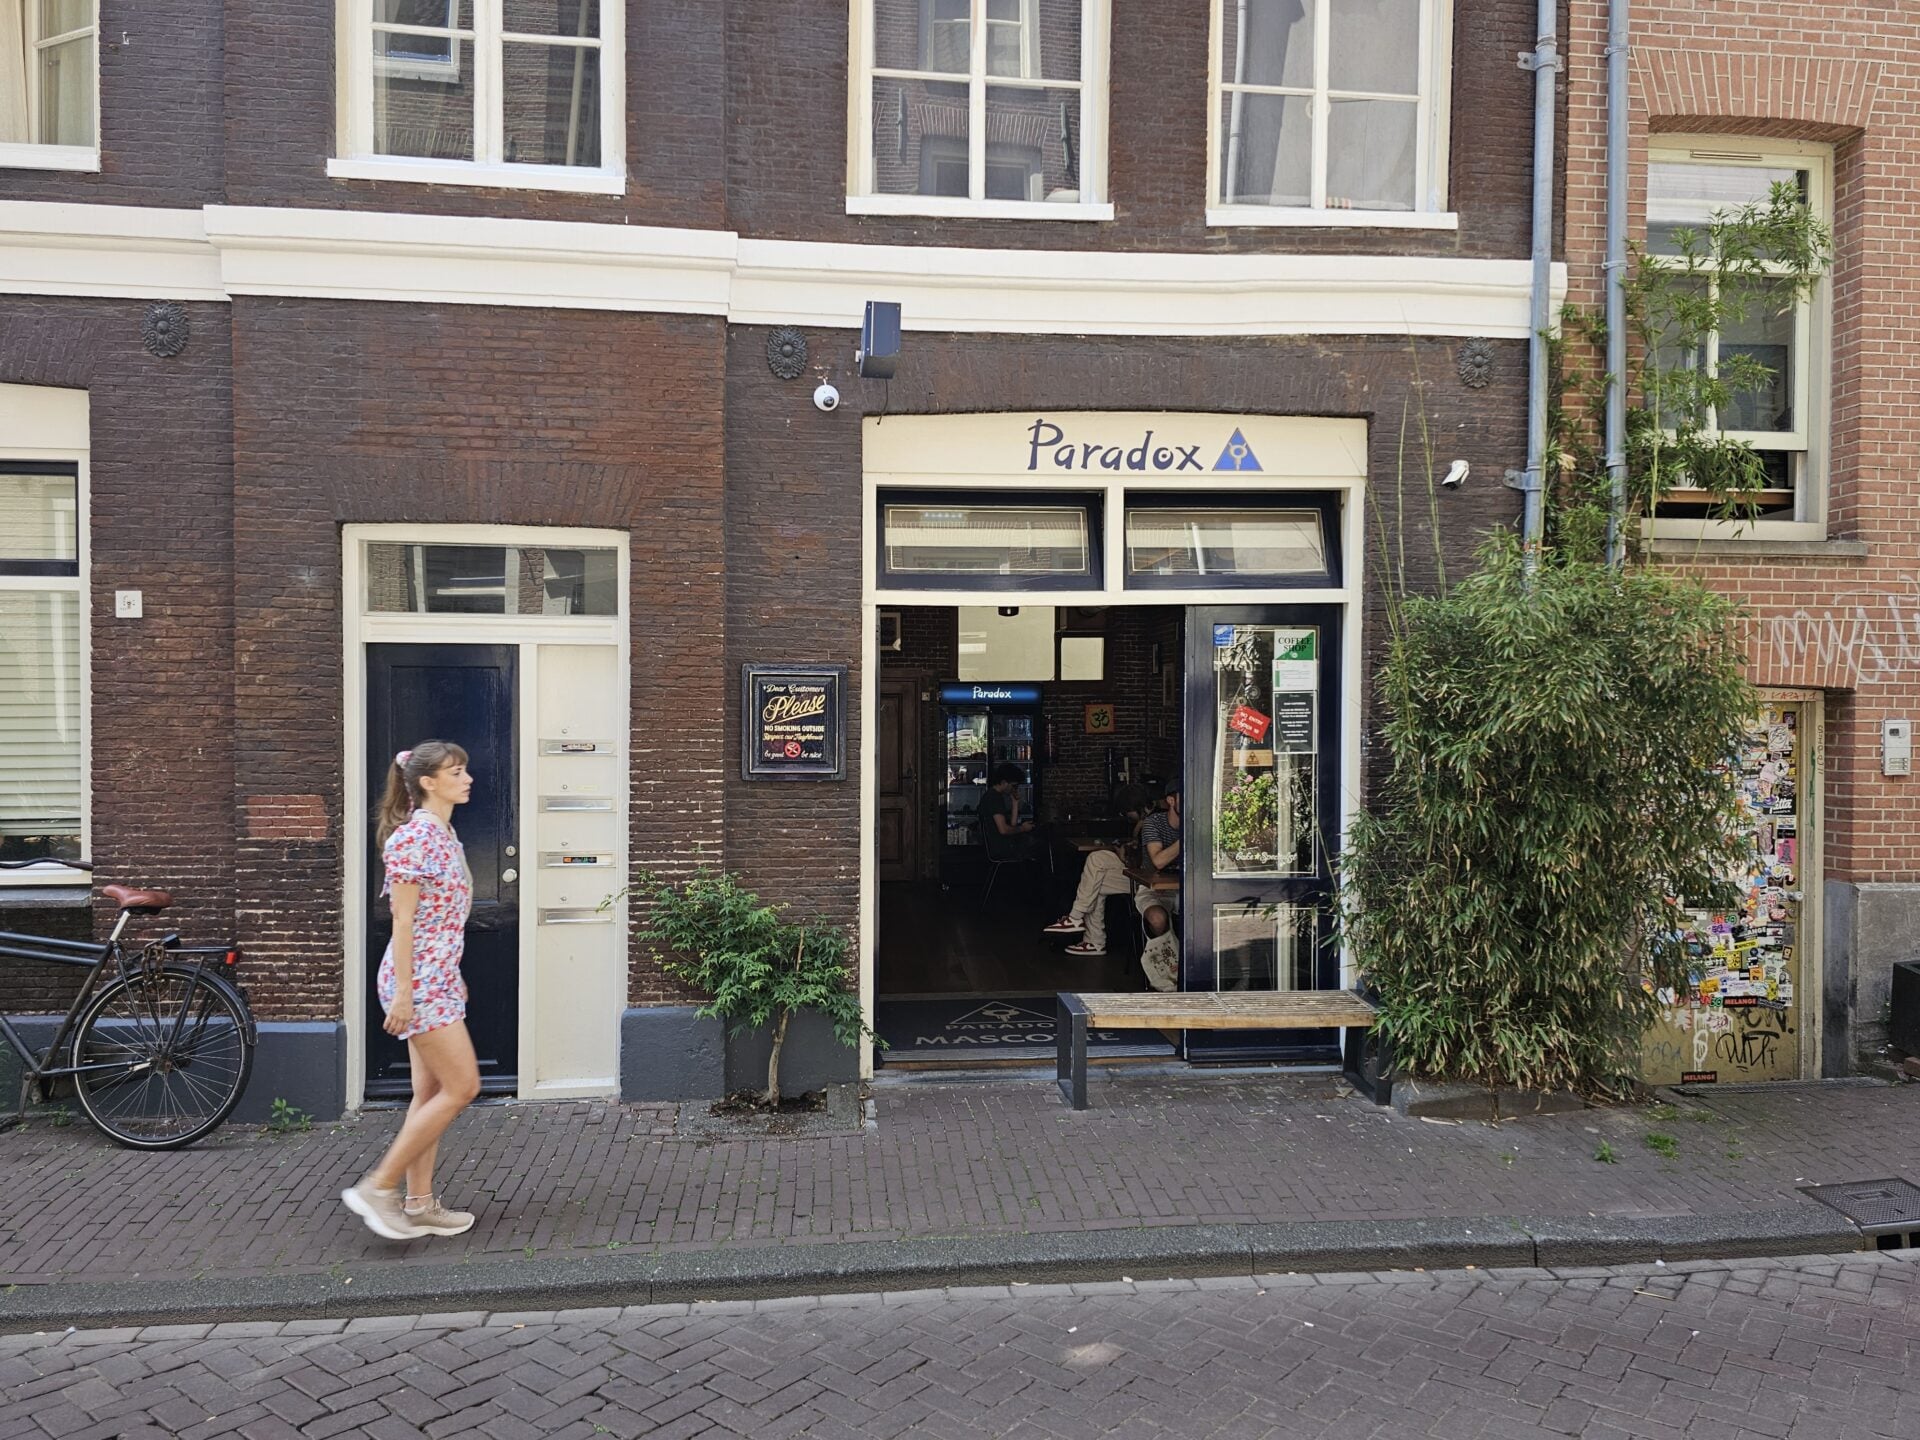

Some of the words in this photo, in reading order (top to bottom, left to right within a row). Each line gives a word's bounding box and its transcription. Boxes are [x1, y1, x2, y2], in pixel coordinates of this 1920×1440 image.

[1027, 418, 1204, 472] Paradox
[1278, 636, 1312, 645] COFFEE
[1283, 644, 1307, 652] SHOP
[972, 686, 1012, 699] Paradox
[763, 694, 826, 723] Please
[945, 1023, 1055, 1031] PARADO
[915, 1032, 1119, 1045] MASCOTE
[1683, 1074, 1716, 1082] MELANGE
